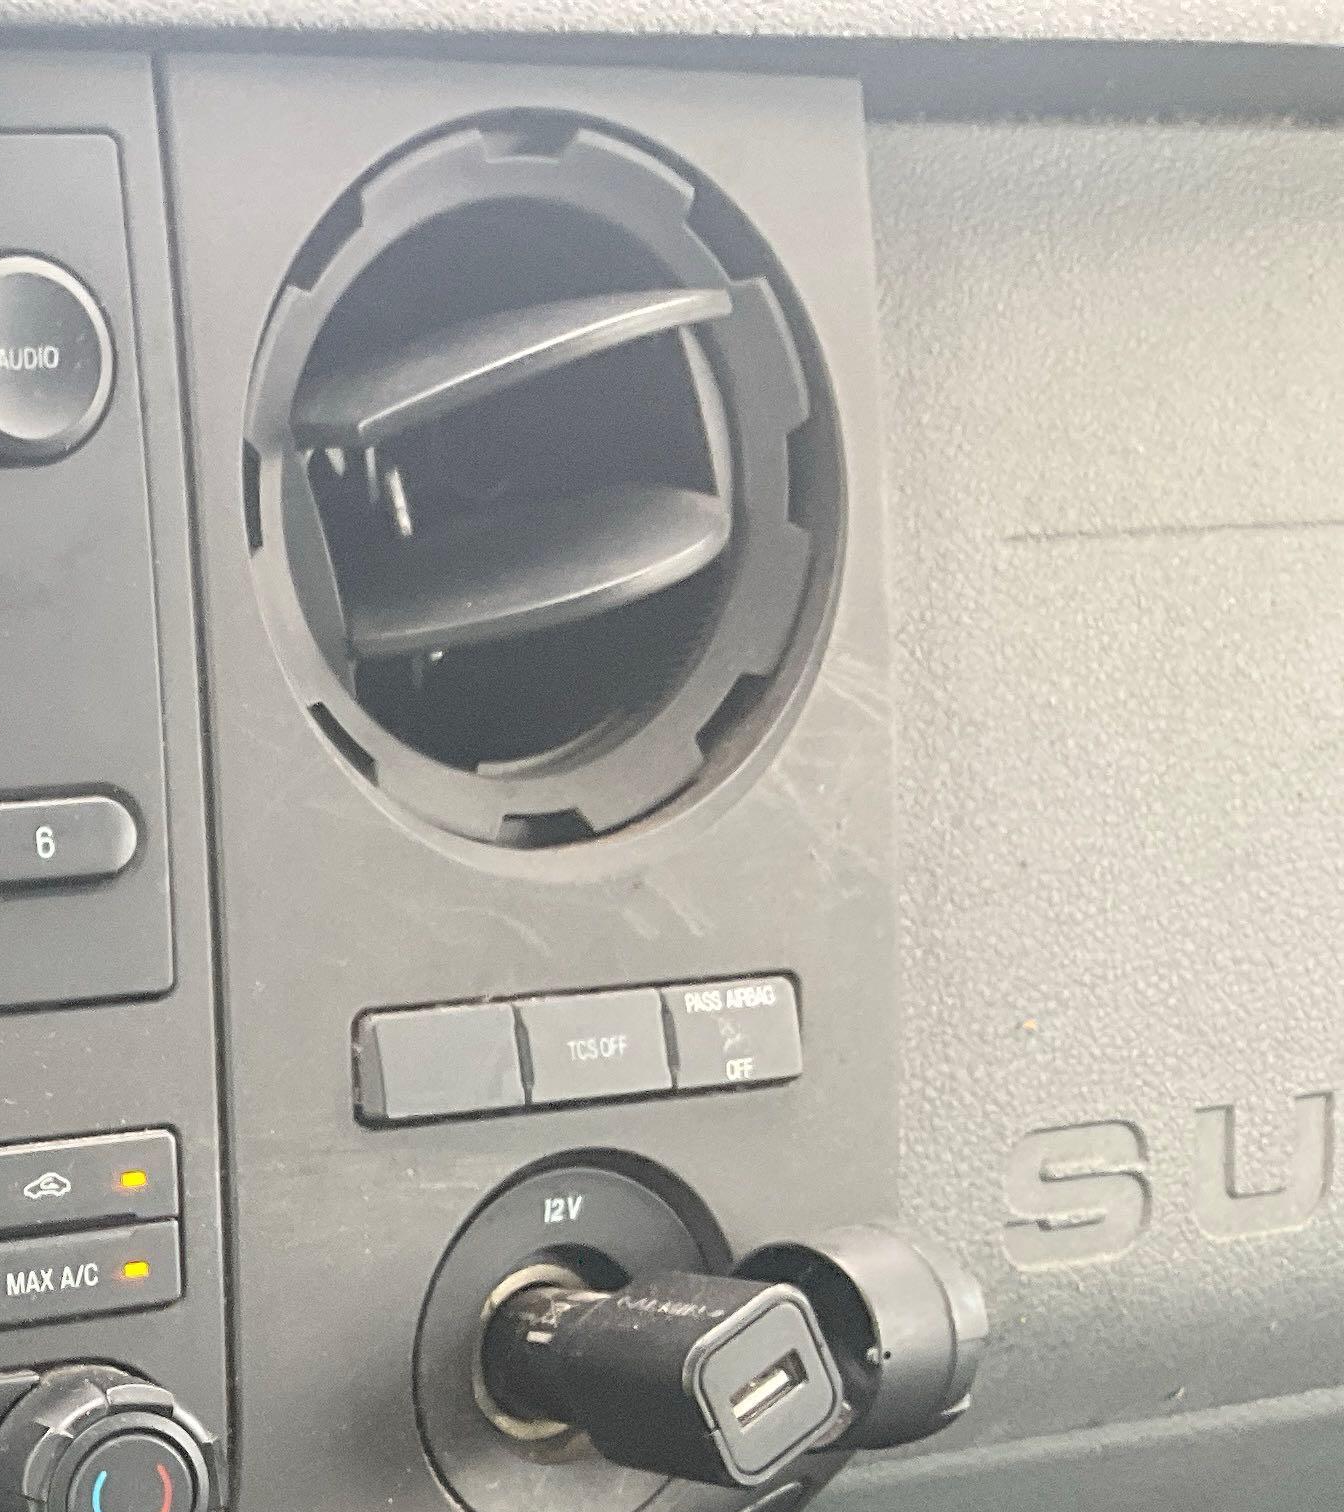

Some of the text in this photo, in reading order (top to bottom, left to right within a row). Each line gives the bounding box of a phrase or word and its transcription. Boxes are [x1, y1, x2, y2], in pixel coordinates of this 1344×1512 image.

[34, 828, 57, 861] 6
[683, 984, 778, 1014] PASS AIRBAG
[566, 1035, 628, 1062] TCS OFF
[726, 1057, 755, 1081] OFF
[543, 1194, 584, 1224] 12V
[5, 1262, 99, 1297] MAX A/C
